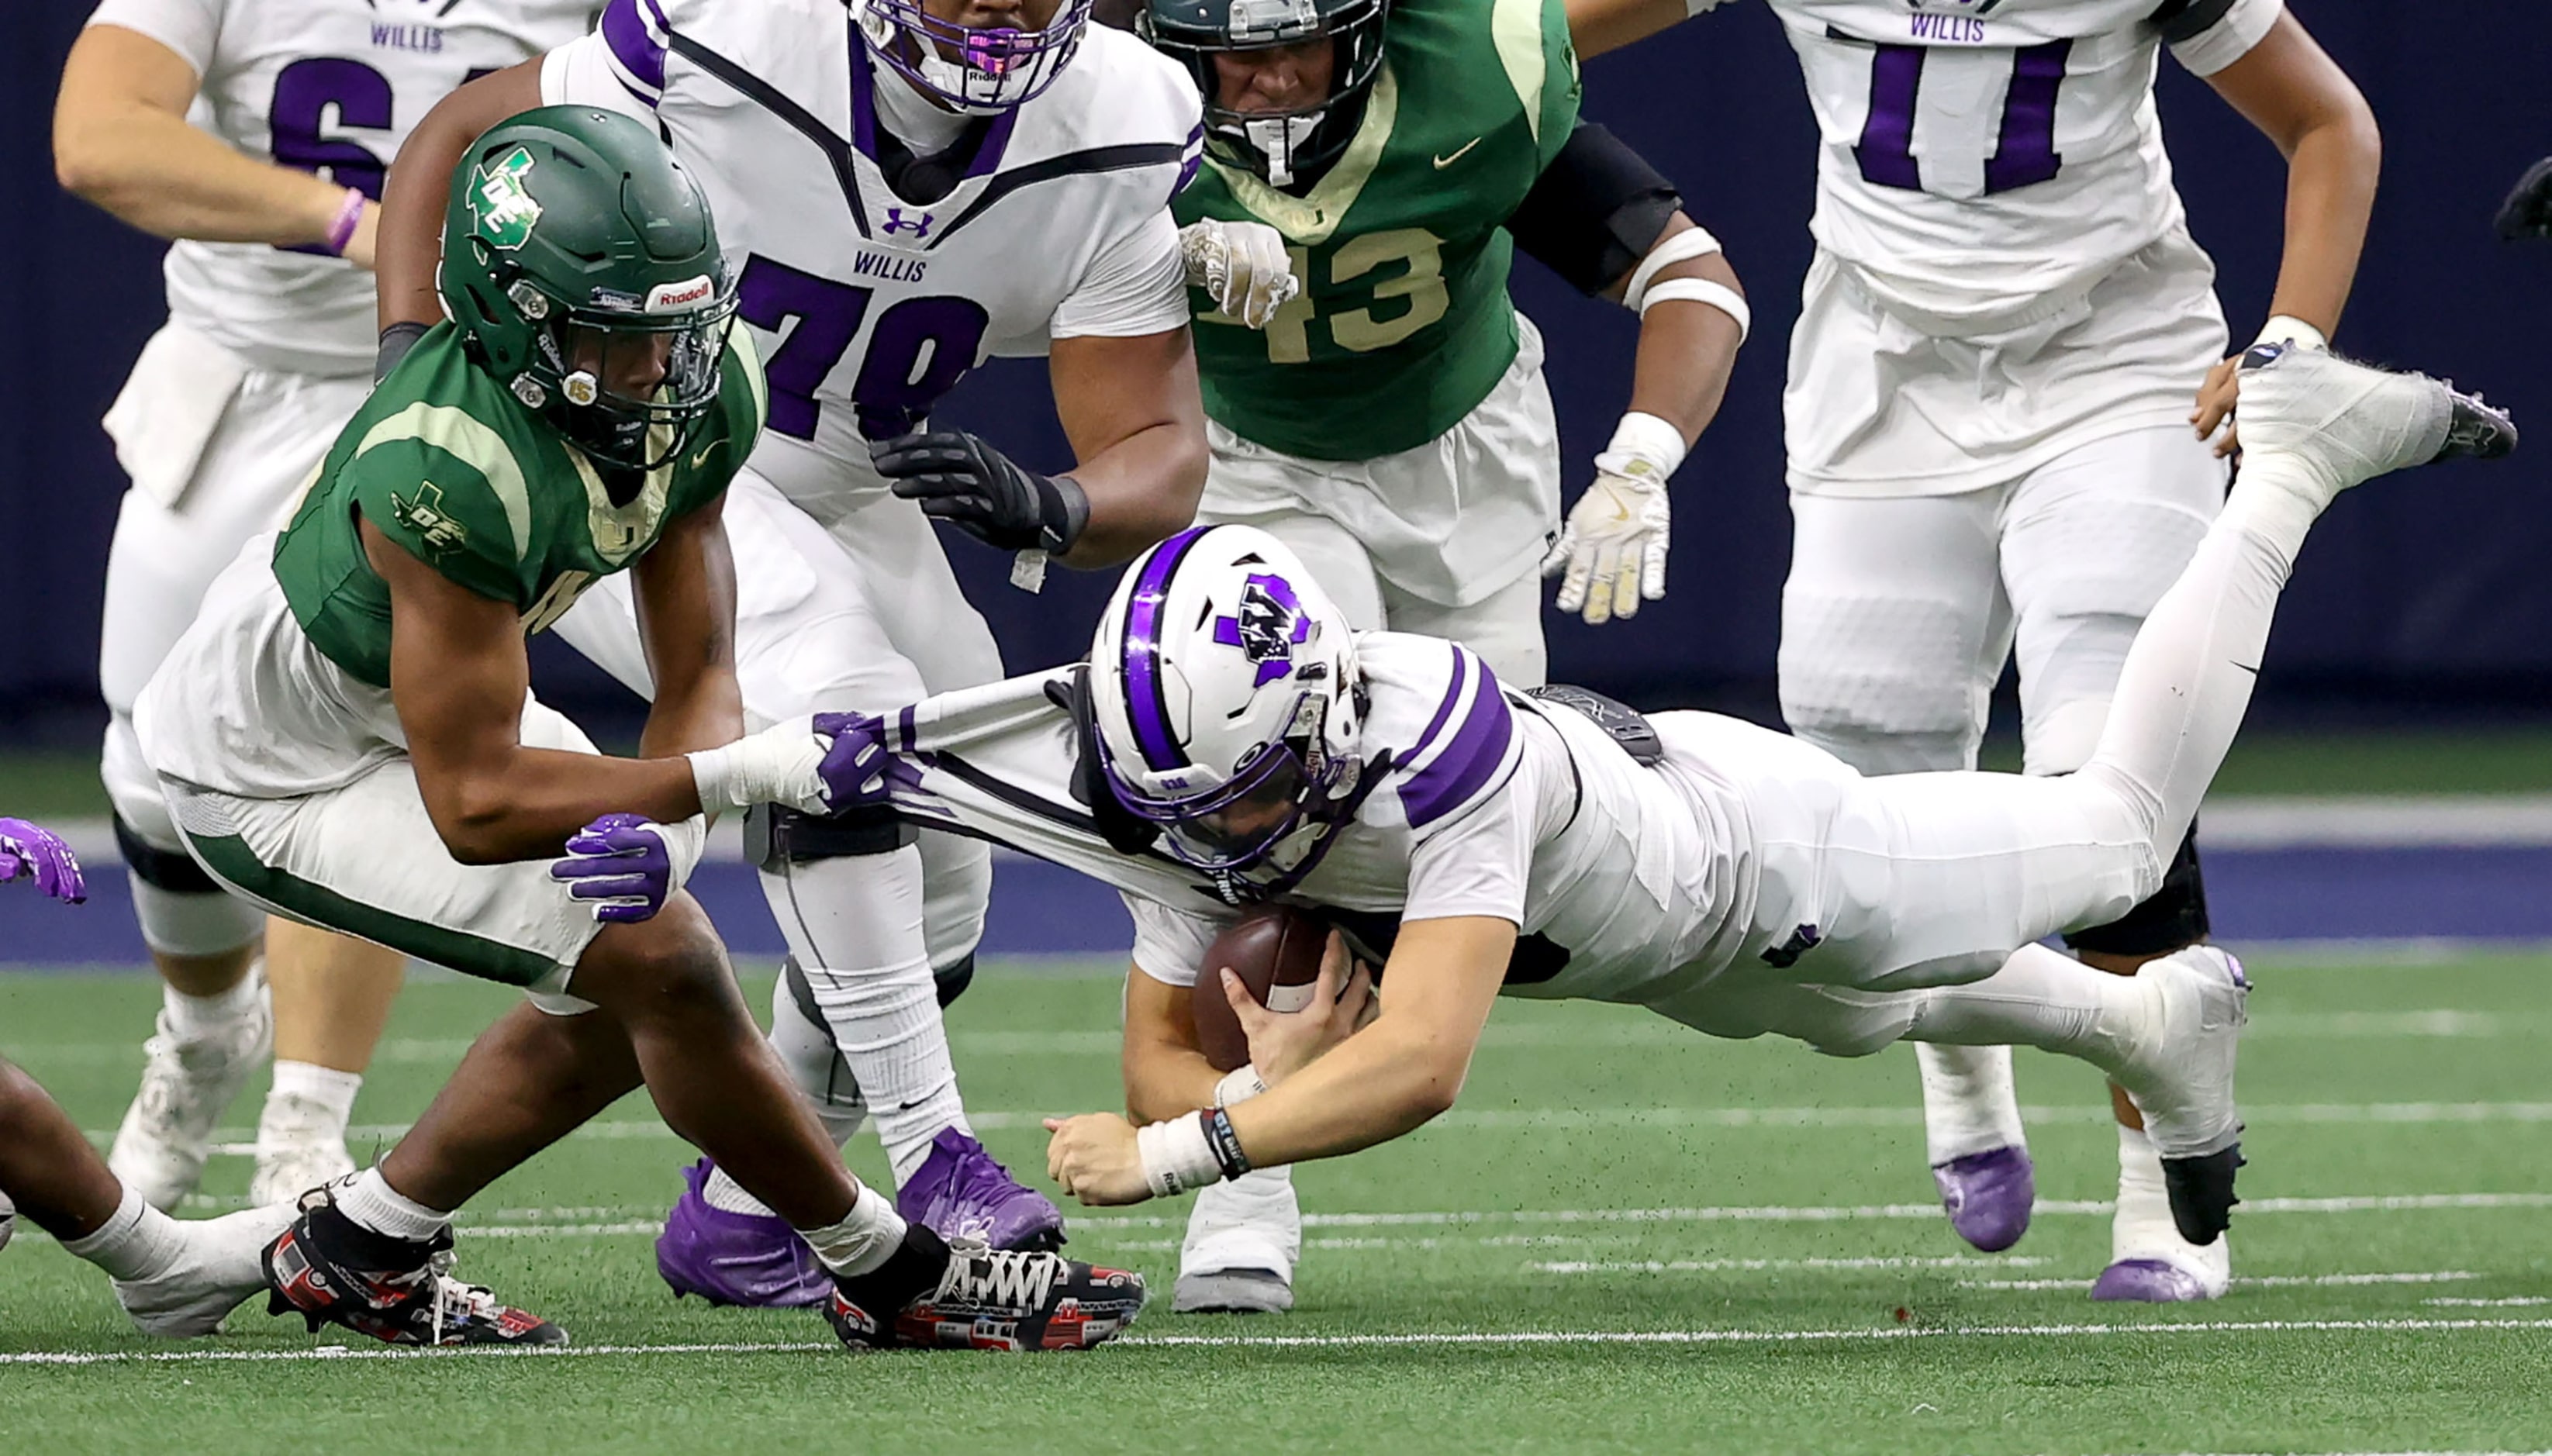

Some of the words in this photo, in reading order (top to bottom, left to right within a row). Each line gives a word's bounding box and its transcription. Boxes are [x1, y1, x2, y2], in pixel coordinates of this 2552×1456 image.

[371, 22, 442, 53] WILLIS
[1911, 12, 1984, 42] WILLIS
[969, 72, 1011, 82] Riddll
[854, 250, 927, 282] WILLIS
[661, 282, 709, 306] Riddell
[568, 381, 592, 402] 15
